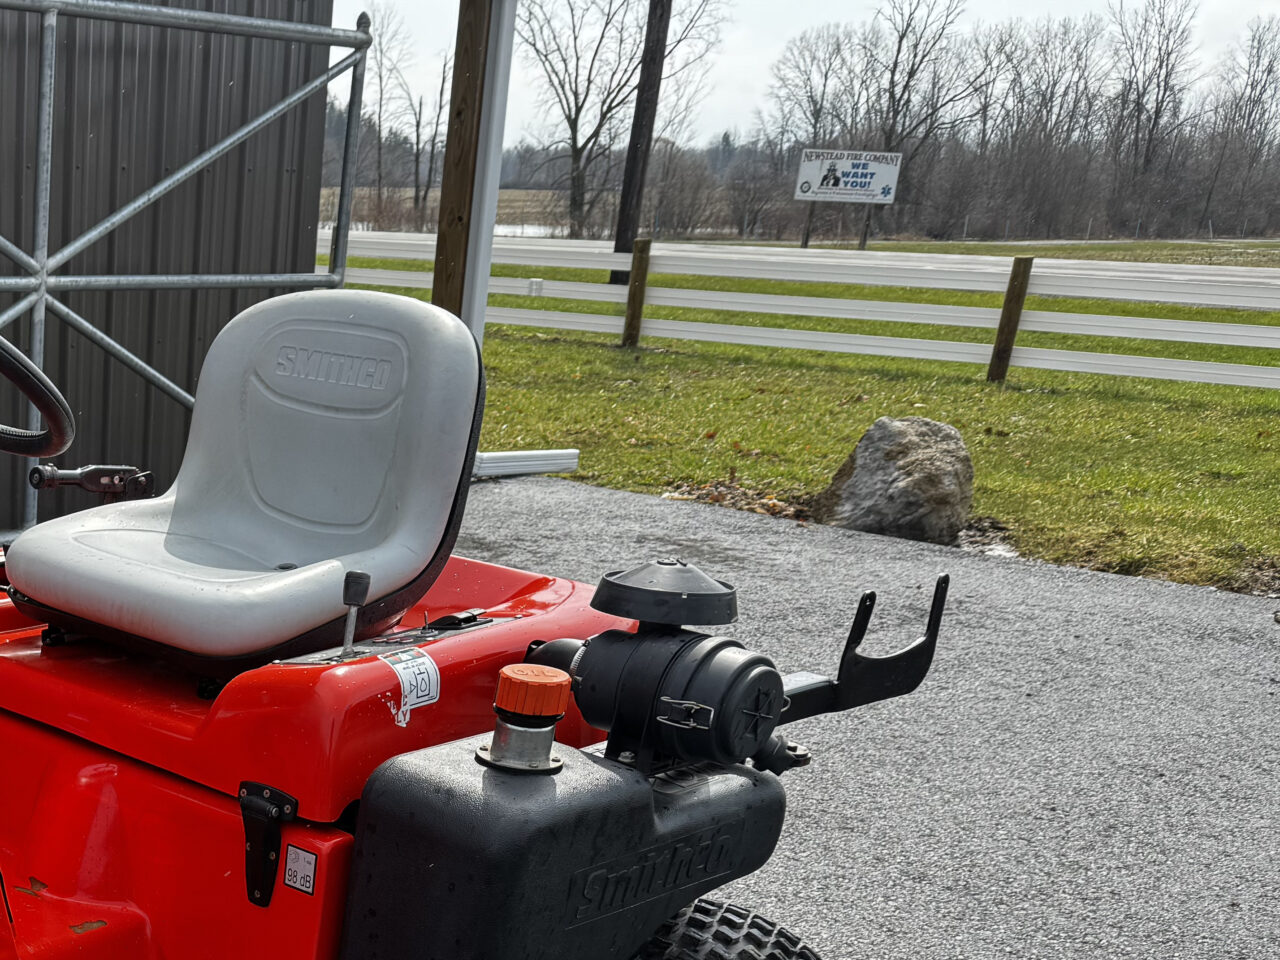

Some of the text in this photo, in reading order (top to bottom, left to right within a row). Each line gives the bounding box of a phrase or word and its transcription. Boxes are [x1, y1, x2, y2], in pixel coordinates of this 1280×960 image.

[803, 150, 901, 166] NEWSTEAD FIRE COMPANY
[851, 162, 869, 170] WE
[841, 171, 876, 179] WANT
[843, 180, 871, 188] YOU!
[276, 345, 392, 389] SMITHCO
[287, 868, 311, 888] 98 dB
